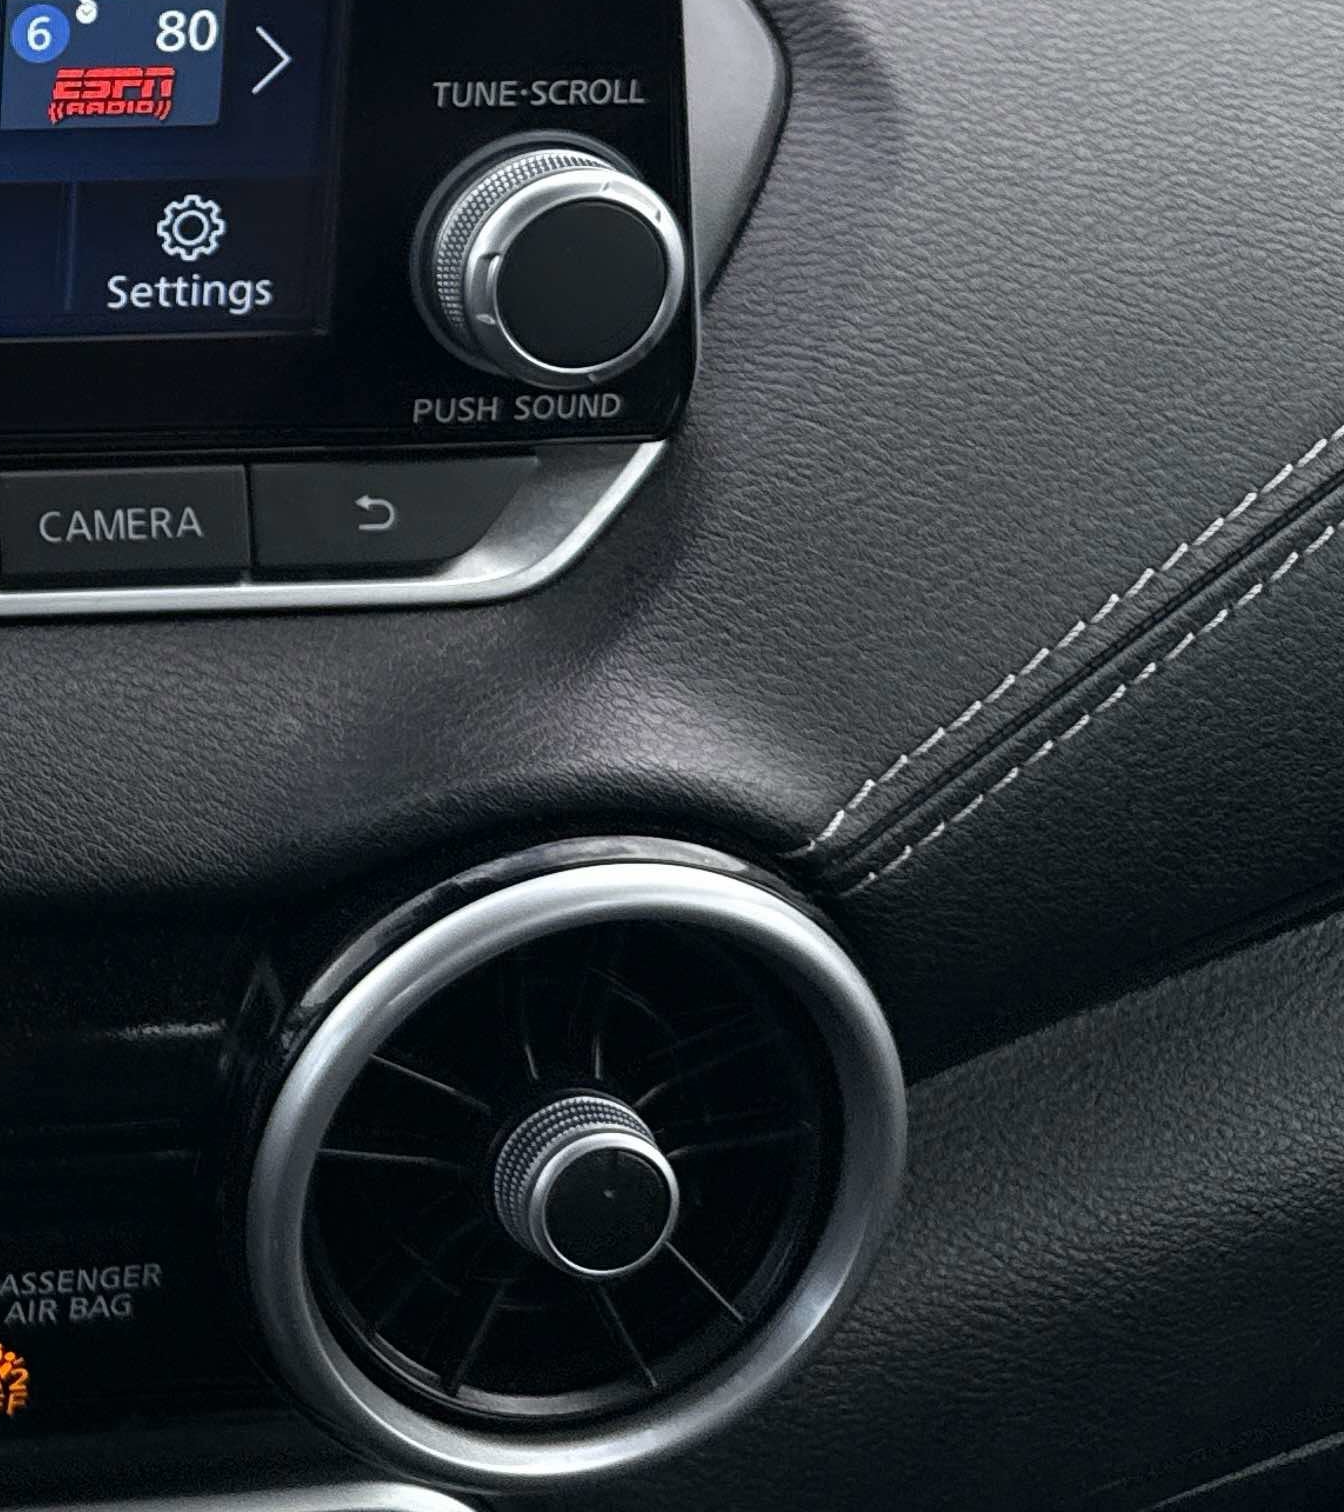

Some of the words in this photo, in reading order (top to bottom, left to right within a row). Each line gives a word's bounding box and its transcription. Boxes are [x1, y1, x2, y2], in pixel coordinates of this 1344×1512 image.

[27, 17, 52, 52] 6
[156, 10, 218, 52] 80
[53, 66, 176, 100] ESPN
[107, 275, 273, 315] Settings
[412, 397, 499, 423] PUSH
[513, 393, 621, 421] SOUND
[38, 506, 203, 544] CAMERA
[4, 1298, 58, 1325] AIR
[69, 1292, 133, 1321] BAG
